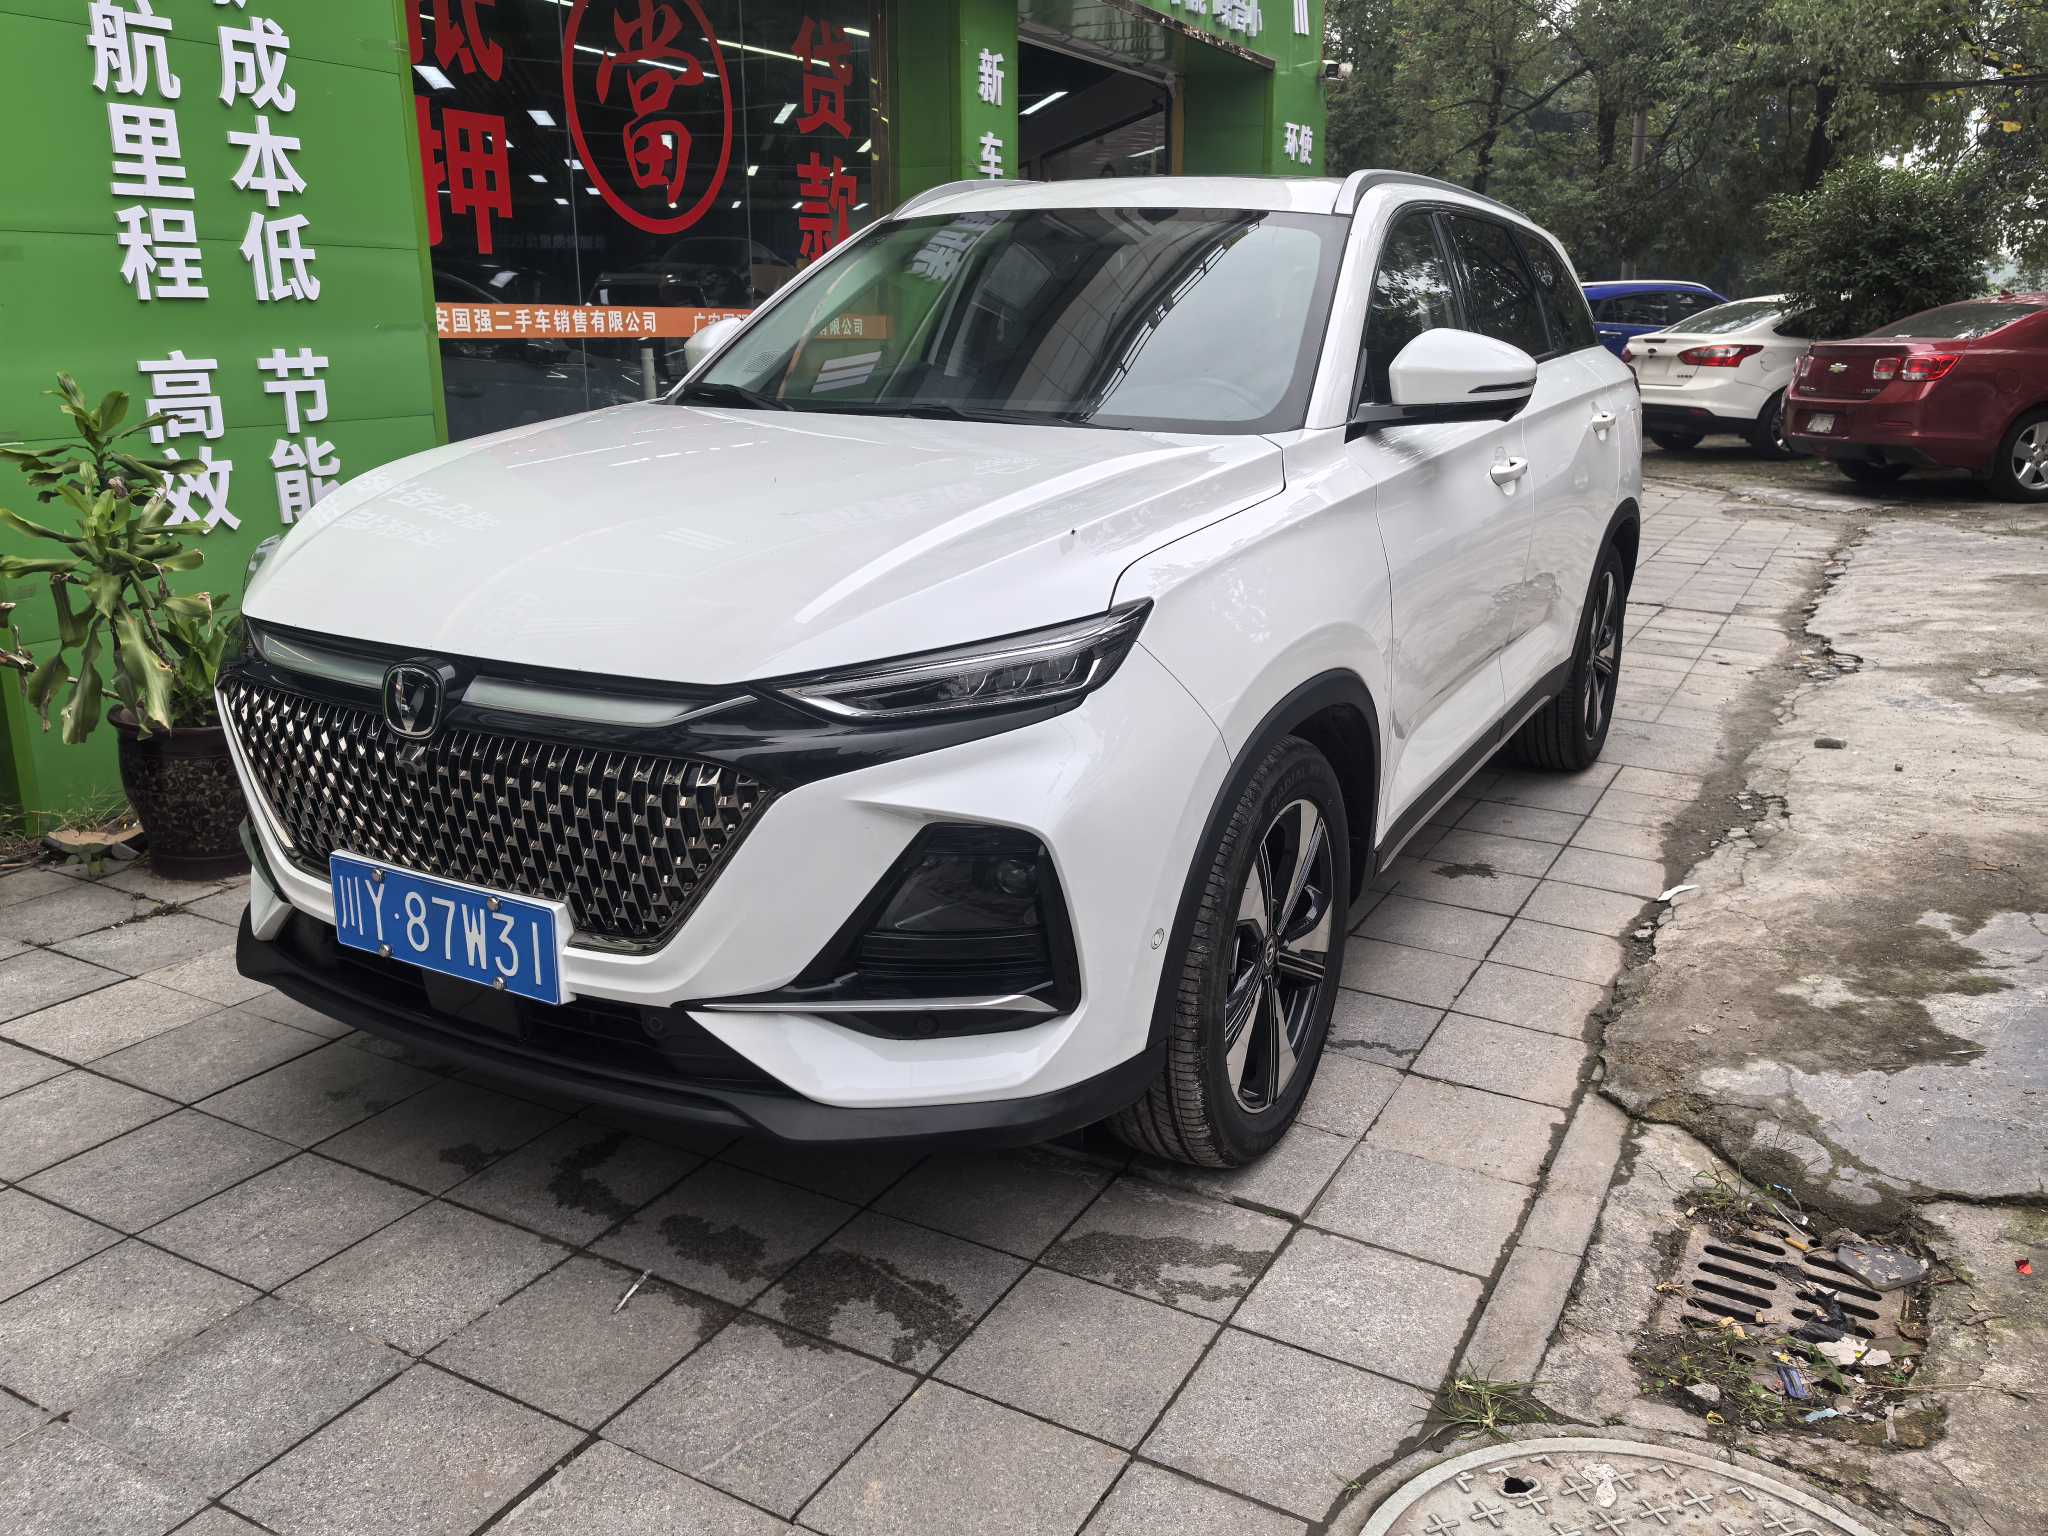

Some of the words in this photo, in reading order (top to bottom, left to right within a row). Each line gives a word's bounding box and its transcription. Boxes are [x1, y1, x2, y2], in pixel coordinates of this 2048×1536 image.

[87, 0, 209, 301] 航里程
[213, 0, 321, 301] 成本低
[792, 15, 857, 262] 贷款
[978, 48, 1005, 180] 新车
[435, 307, 656, 333] 安国强二手车销售有限公司
[137, 350, 242, 536] 高效
[256, 347, 341, 525] 节能
[339, 874, 542, 986] 川Y·87W31
